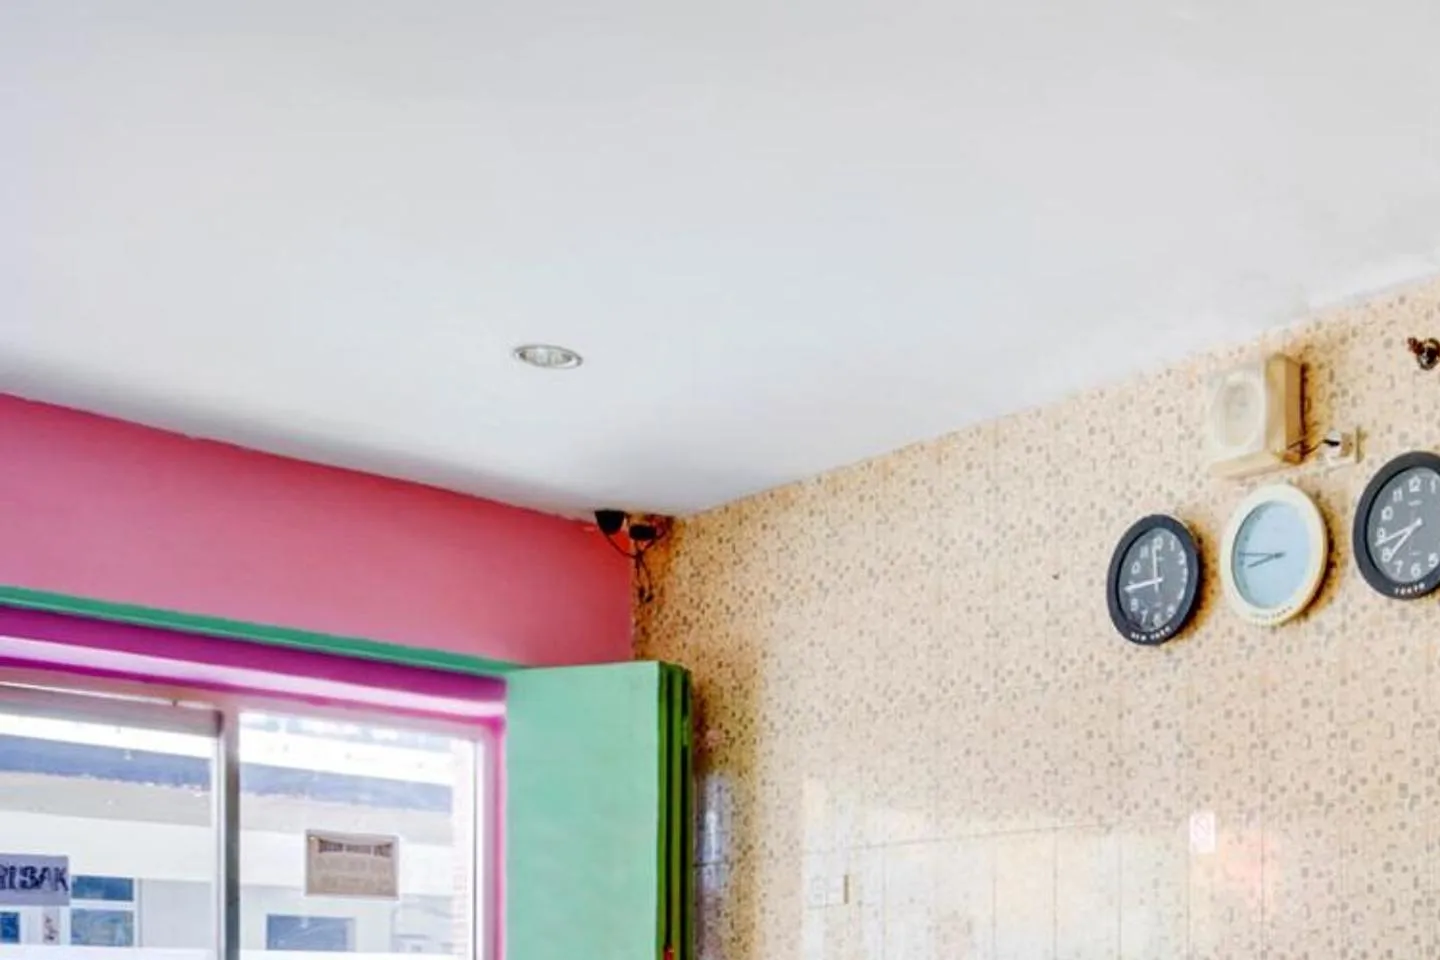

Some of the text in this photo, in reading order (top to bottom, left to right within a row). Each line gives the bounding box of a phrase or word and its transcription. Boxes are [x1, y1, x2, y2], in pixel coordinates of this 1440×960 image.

[1430, 479, 1436, 494] 1
[1393, 560, 1404, 575] 7
[1427, 552, 1439, 568] 5
[1411, 563, 1421, 577] 6
